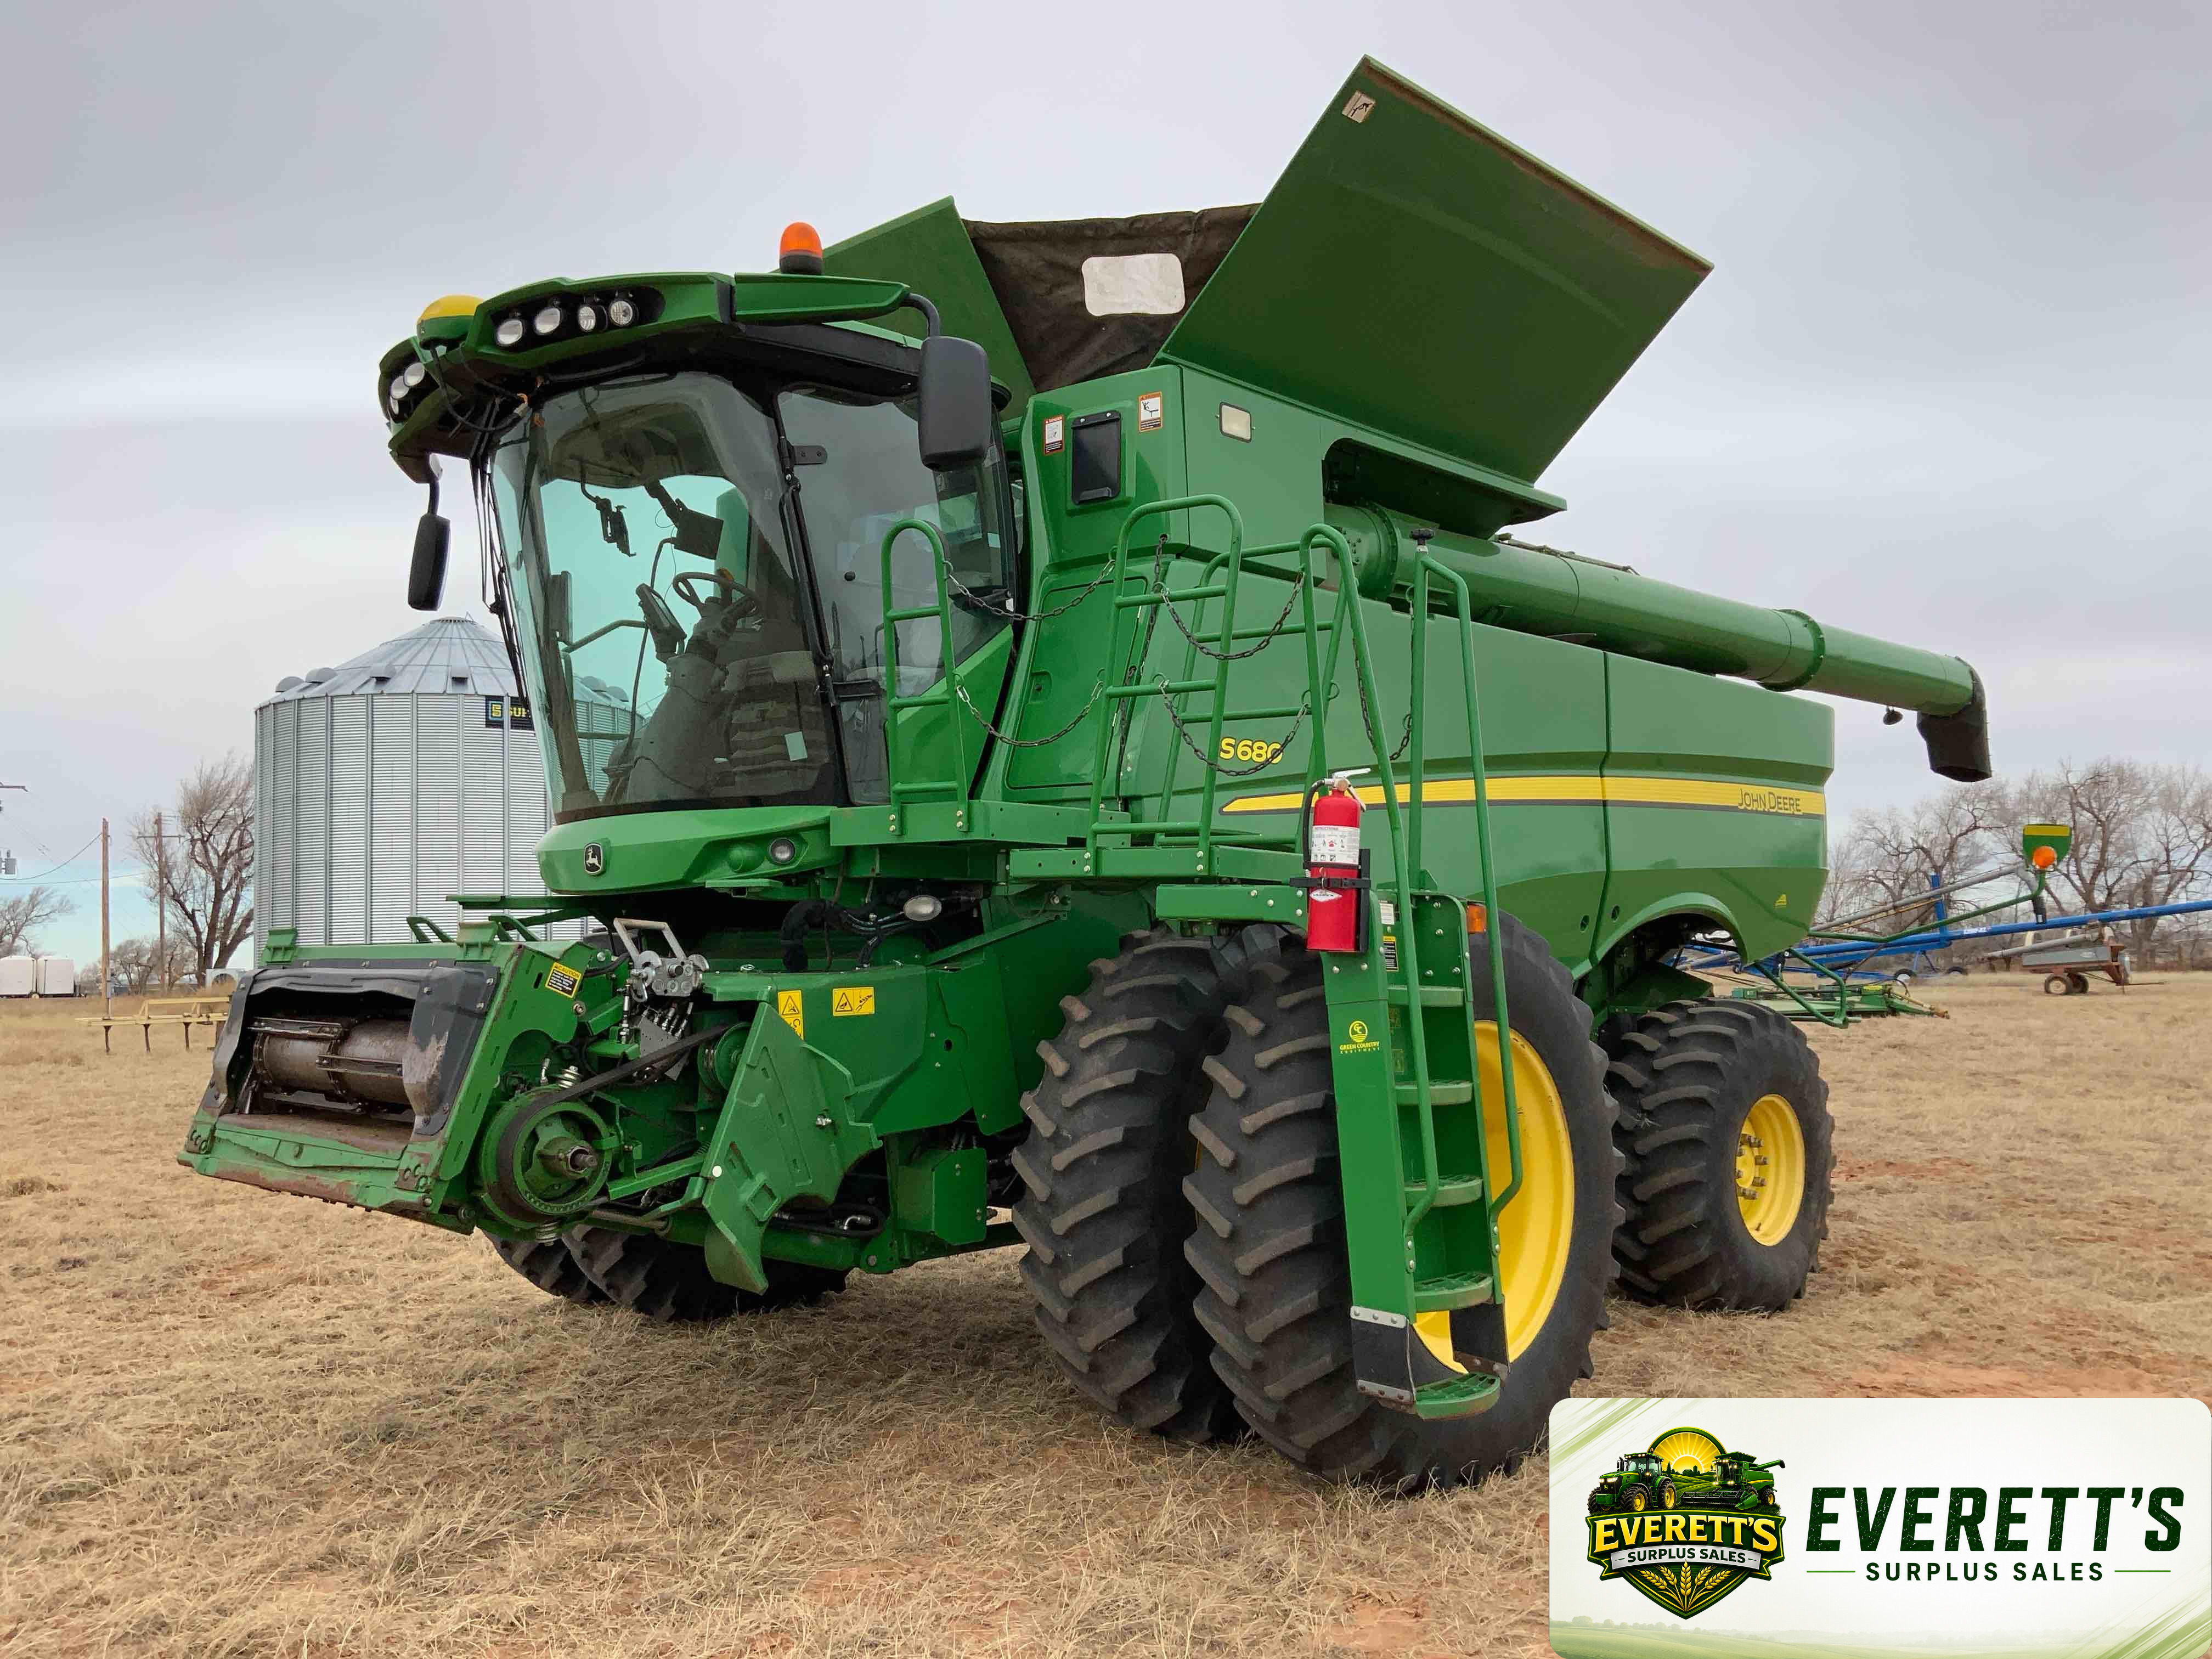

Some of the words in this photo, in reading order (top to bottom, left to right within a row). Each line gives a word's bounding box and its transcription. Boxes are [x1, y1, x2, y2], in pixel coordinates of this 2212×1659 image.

[1220, 737, 1283, 764] S680
[1738, 788, 1767, 809] JOHN
[1768, 792, 1802, 813] DEERE
